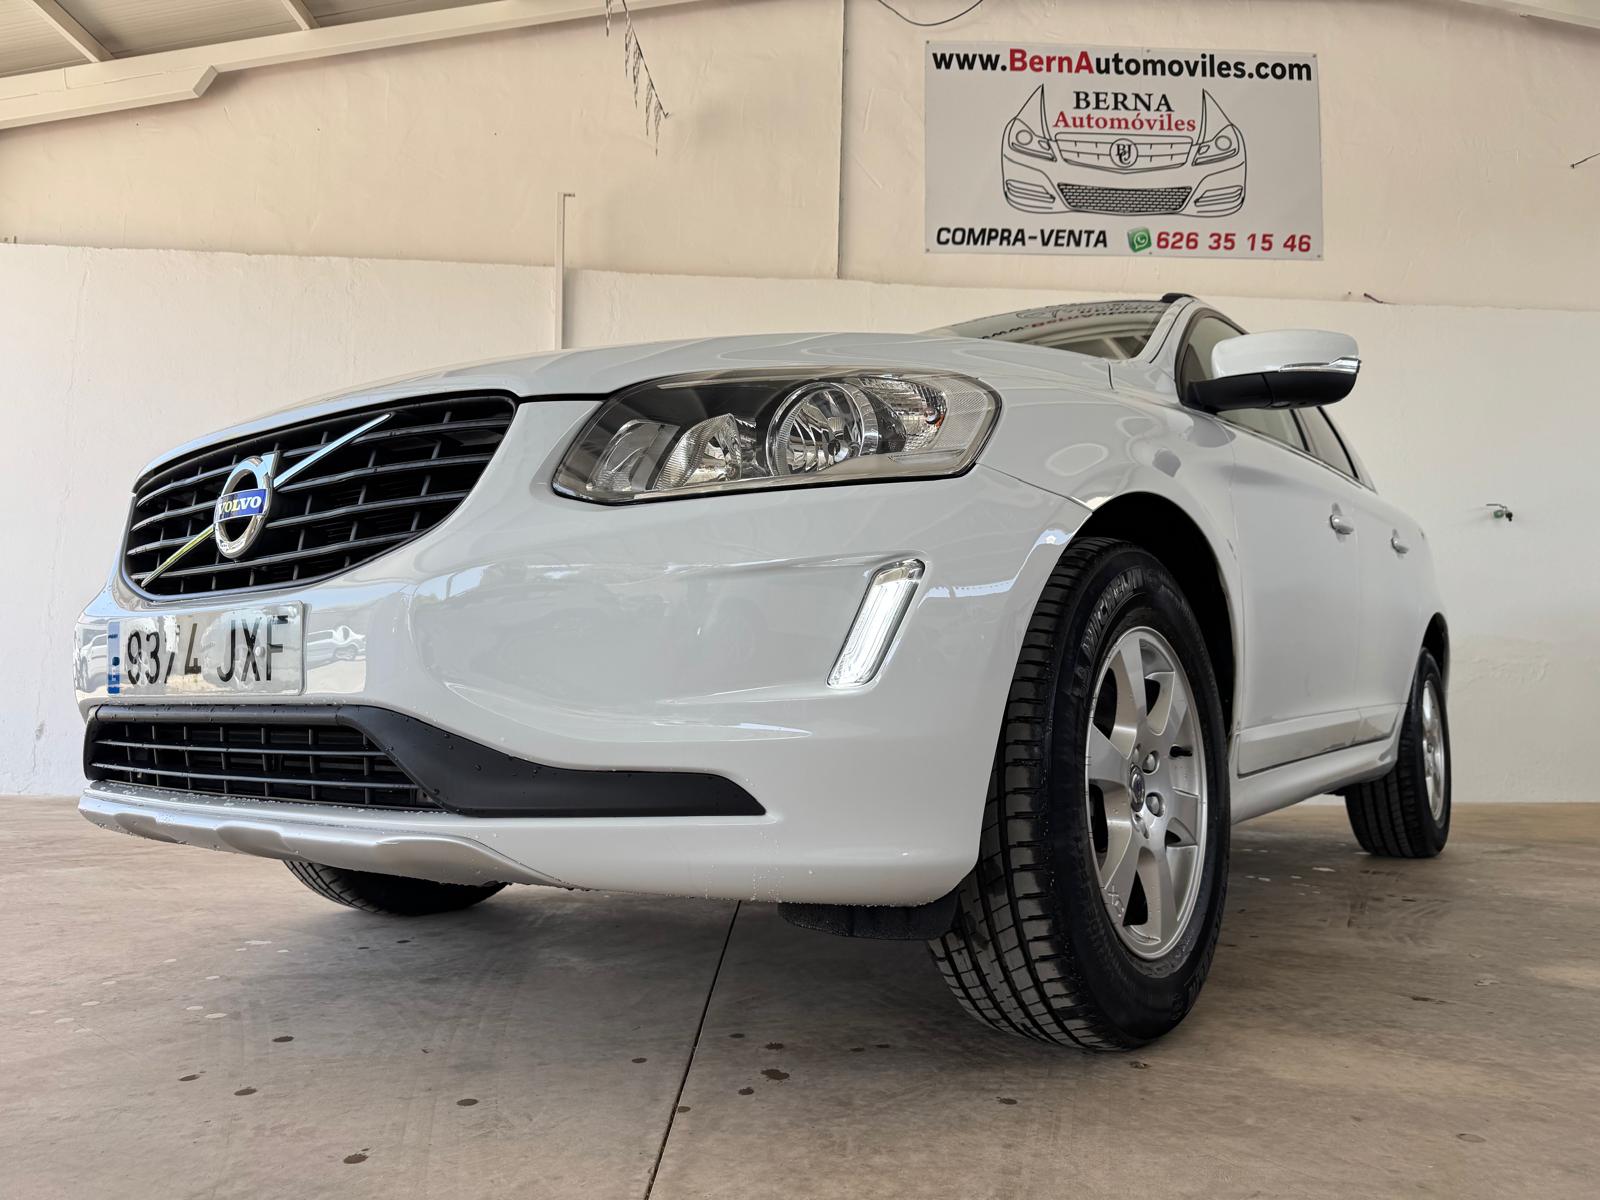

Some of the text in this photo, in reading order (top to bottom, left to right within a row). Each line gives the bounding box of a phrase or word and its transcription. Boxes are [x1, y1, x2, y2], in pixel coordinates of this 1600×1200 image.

[932, 47, 1312, 81] www.BernAutomoviles.com
[1073, 91, 1174, 112] BERNA
[1053, 111, 1197, 131] Automóviles
[936, 226, 1108, 248] COMPRA-VENTA
[1156, 231, 1312, 252] 626 35 15 46
[218, 495, 262, 513] VOLVO
[217, 615, 289, 682] JXF
